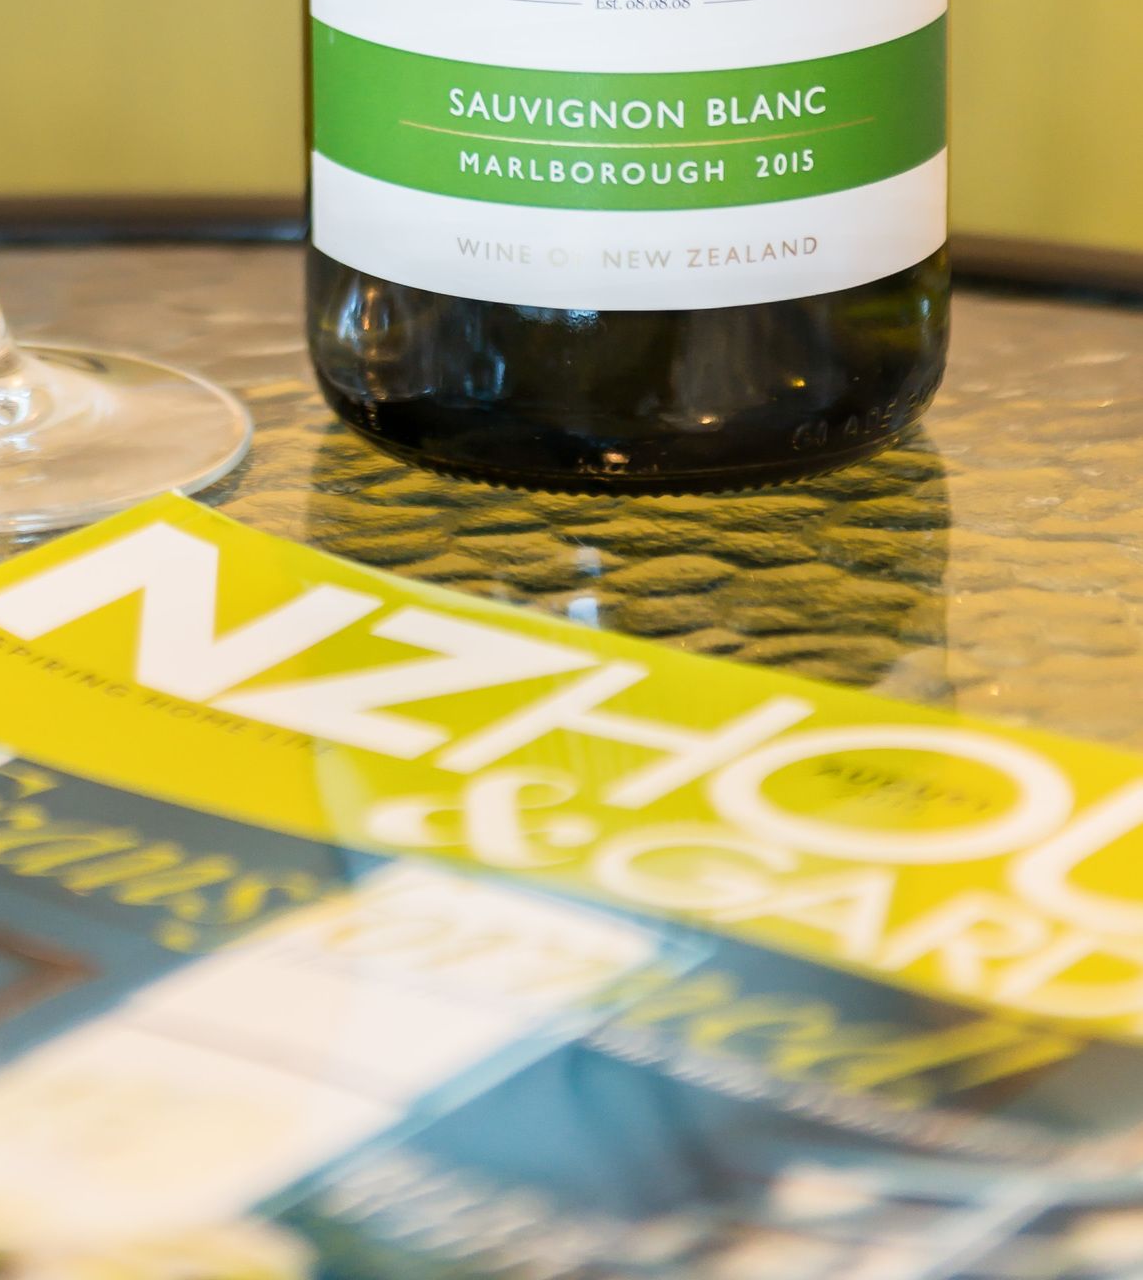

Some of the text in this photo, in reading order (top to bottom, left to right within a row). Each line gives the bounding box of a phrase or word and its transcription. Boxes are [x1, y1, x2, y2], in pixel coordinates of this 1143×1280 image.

[448, 85, 827, 130] SAUVIGNON BLANC
[459, 149, 815, 186] MARLBOROUGH 2015
[457, 237, 532, 265] WINE
[602, 248, 672, 269] NEW
[686, 236, 819, 269] ZEALAND
[141, 694, 252, 736] HOME
